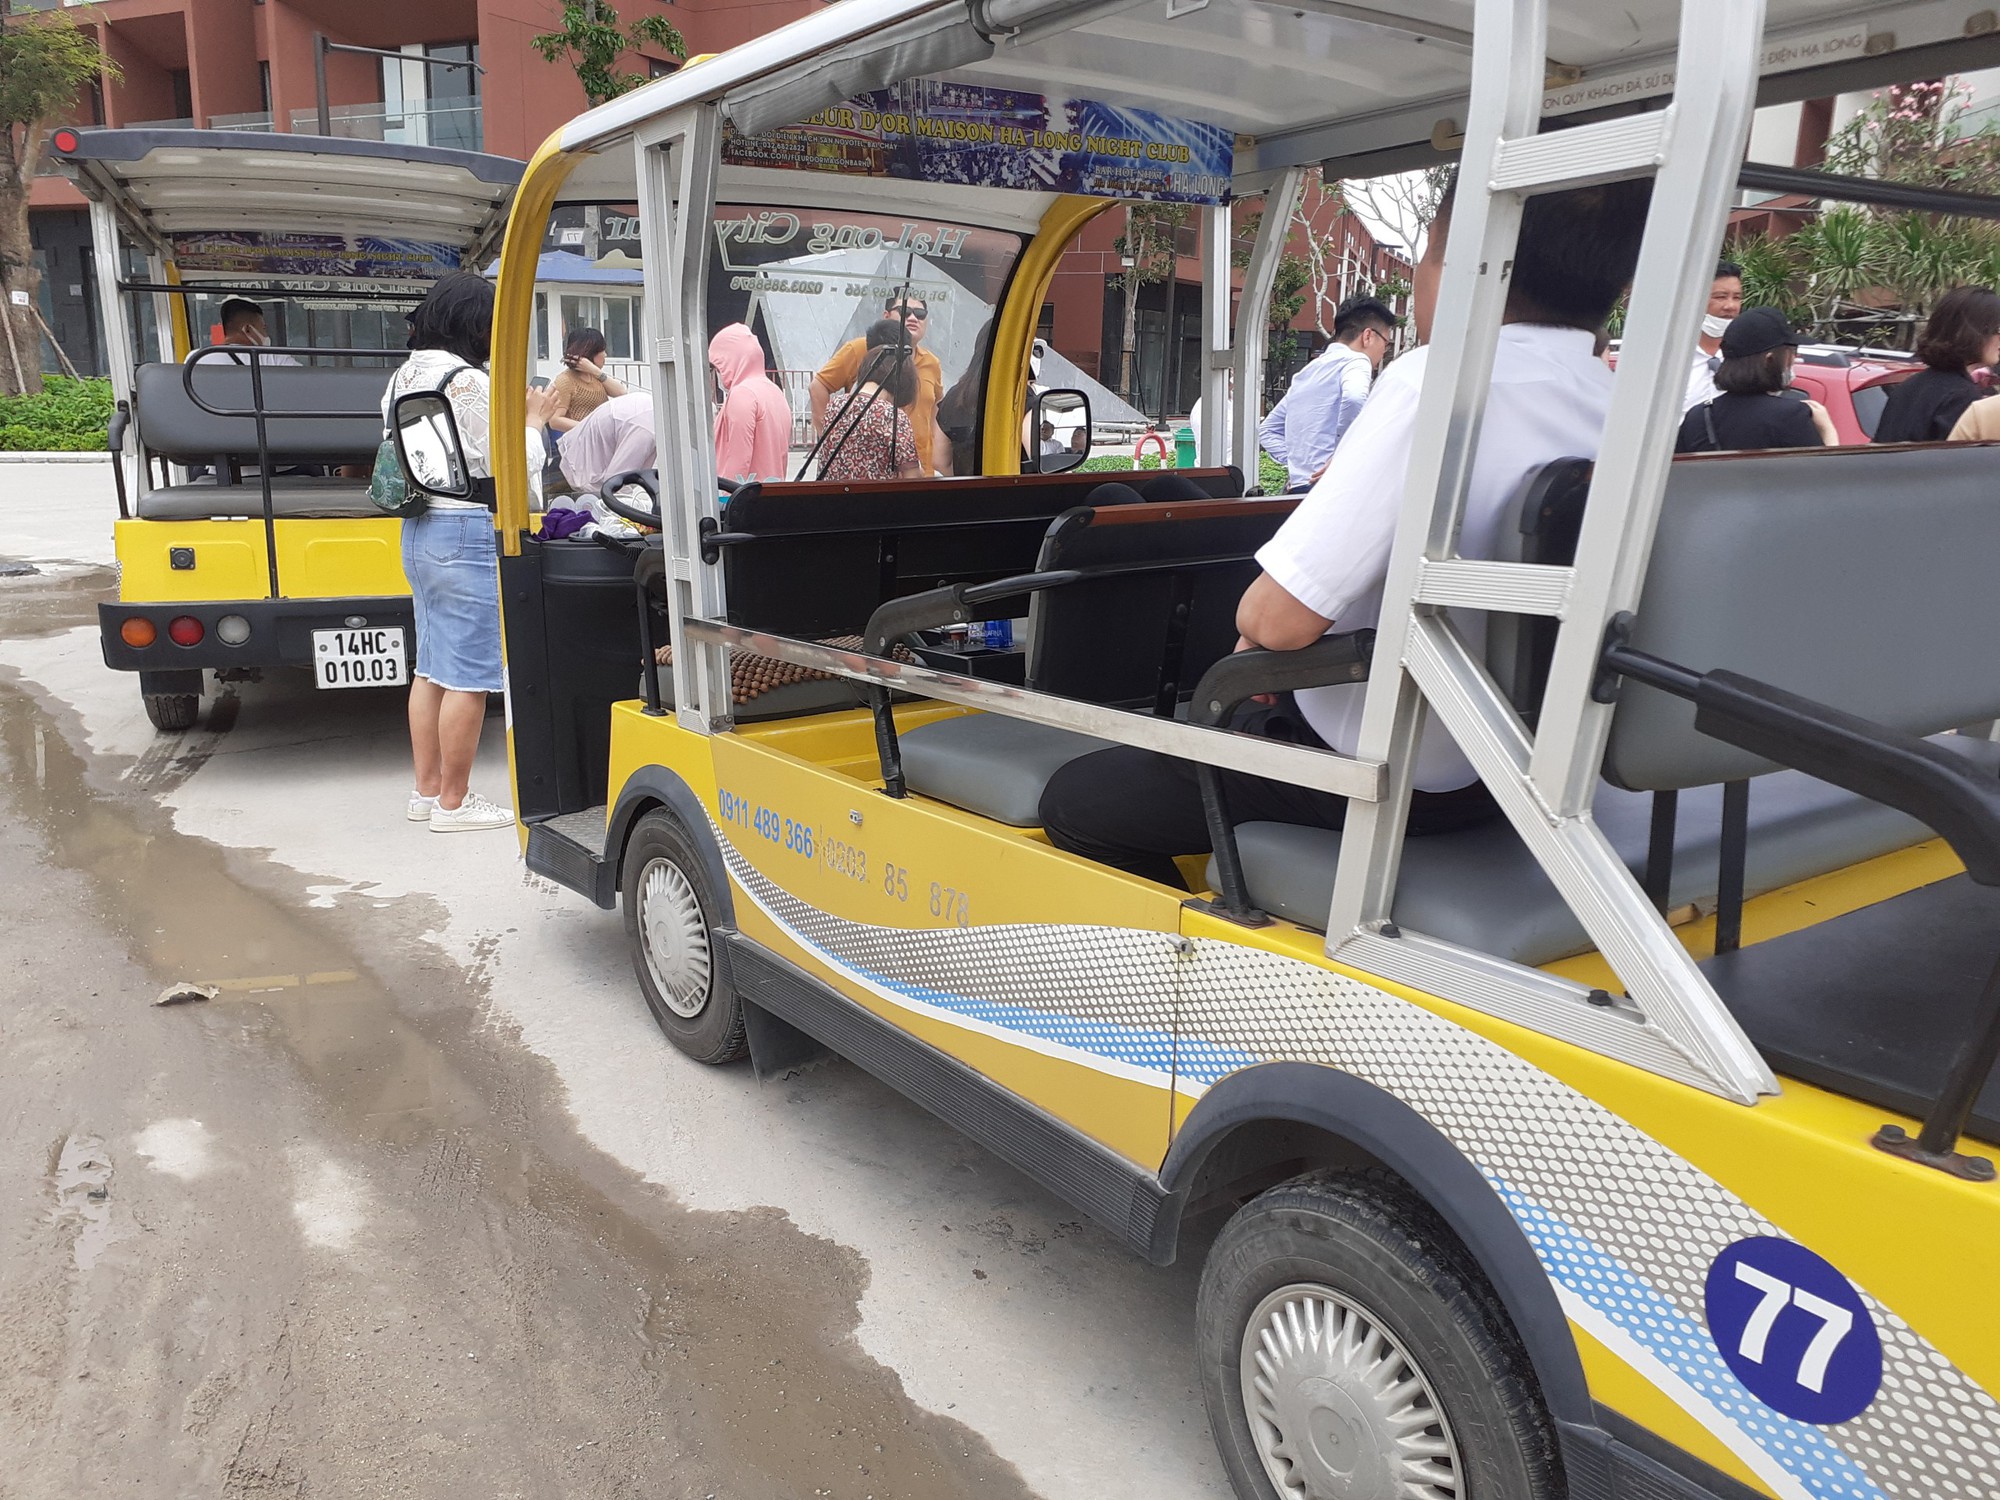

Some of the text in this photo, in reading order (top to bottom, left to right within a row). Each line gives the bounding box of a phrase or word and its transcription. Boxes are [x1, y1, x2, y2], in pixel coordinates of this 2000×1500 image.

[860, 110, 911, 134] D'OR
[915, 117, 994, 143] MAISON
[1033, 130, 1082, 150] LONG
[1086, 136, 1143, 157] NIGHT
[1146, 143, 1190, 162] CLUB
[1095, 165, 1113, 176] BAR
[1115, 167, 1134, 178] HOT
[1194, 174, 1226, 197] LONG
[334, 631, 388, 656] 14HC
[324, 658, 398, 684] 010.03
[718, 787, 750, 829] 0911
[753, 805, 781, 843] 489
[785, 818, 814, 859] 366
[929, 880, 970, 929] 878
[1734, 1260, 1854, 1395] 77
